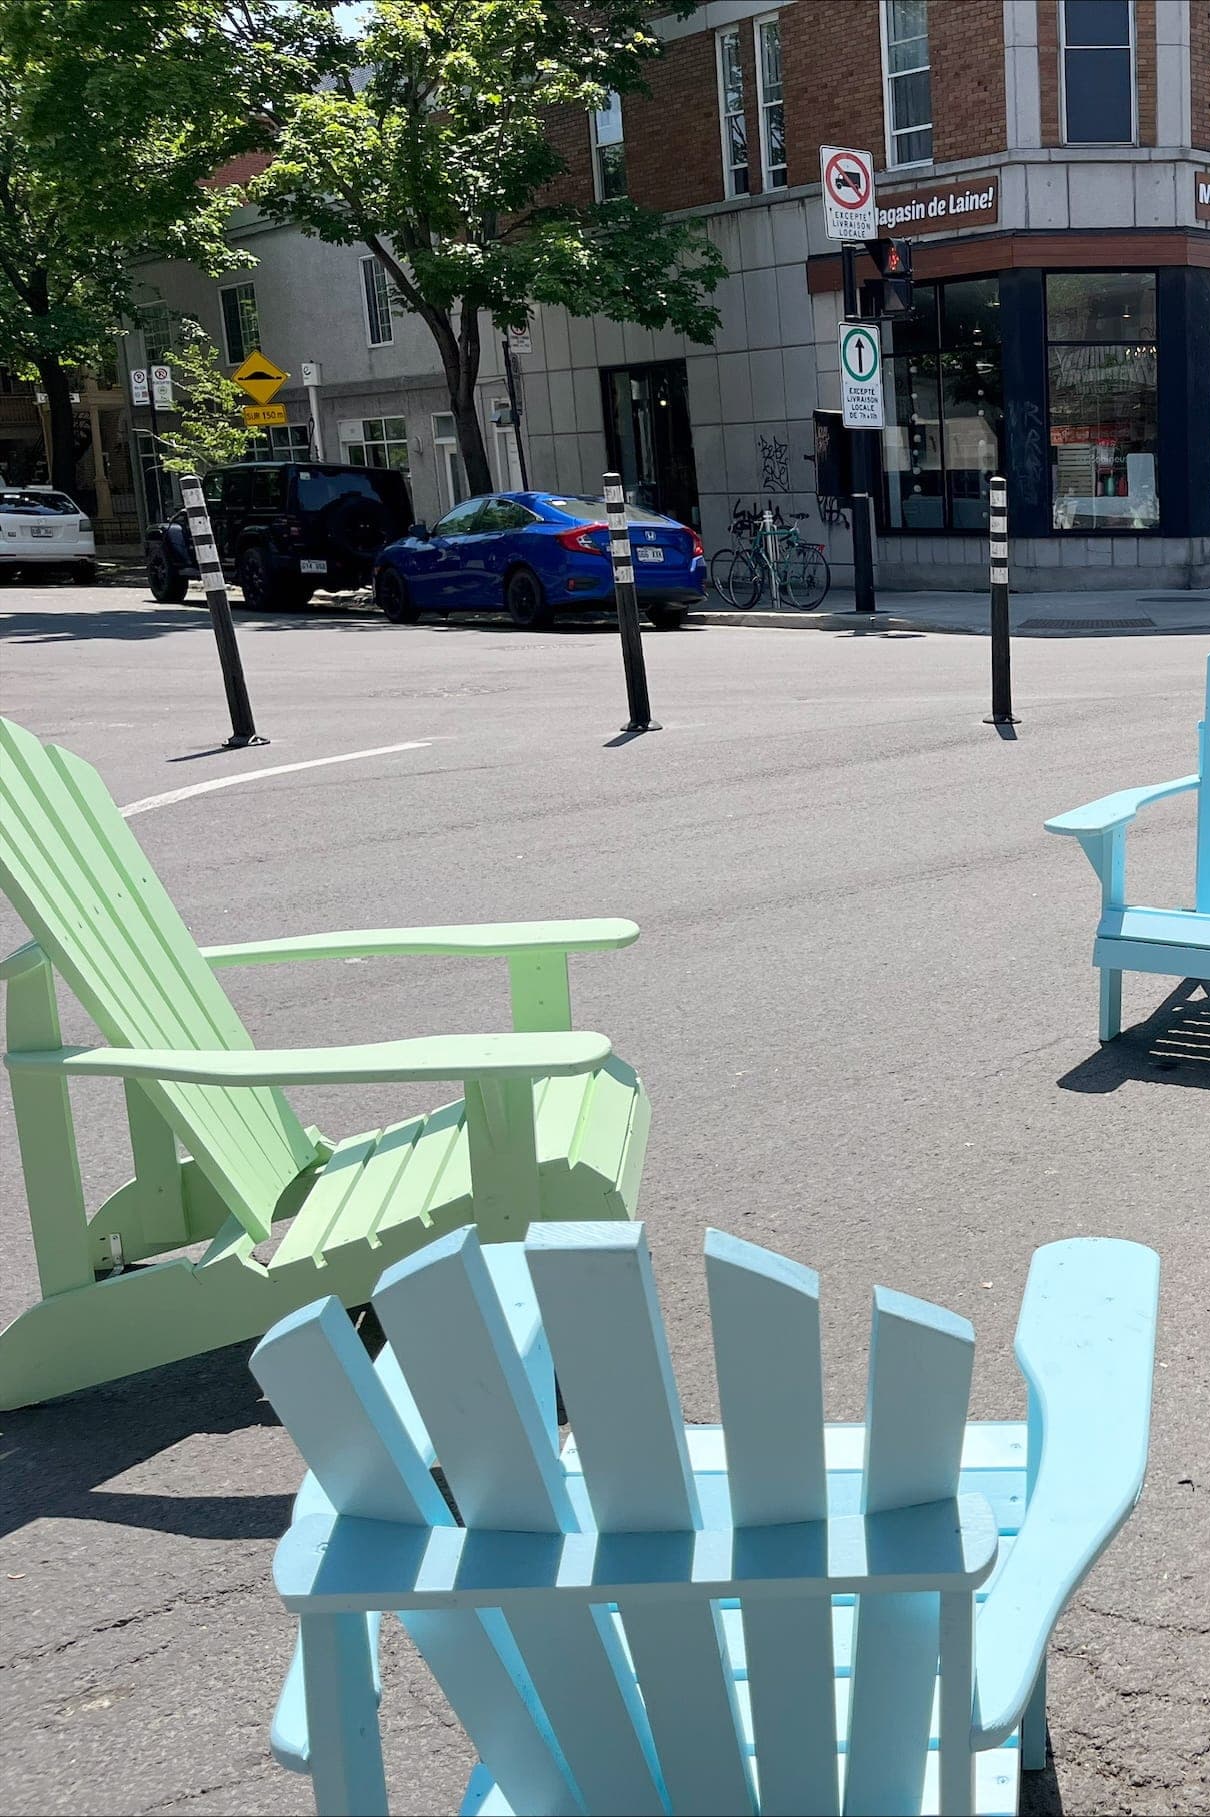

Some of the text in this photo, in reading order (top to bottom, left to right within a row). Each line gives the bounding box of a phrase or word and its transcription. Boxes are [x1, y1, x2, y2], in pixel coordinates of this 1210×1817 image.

[928, 196, 946, 216] de
[949, 187, 994, 215] Laine!
[832, 219, 871, 231] LIVRAISON
[839, 228, 866, 239] LOCALE
[851, 403, 875, 412] LOCALE
[262, 411, 276, 420] 150
